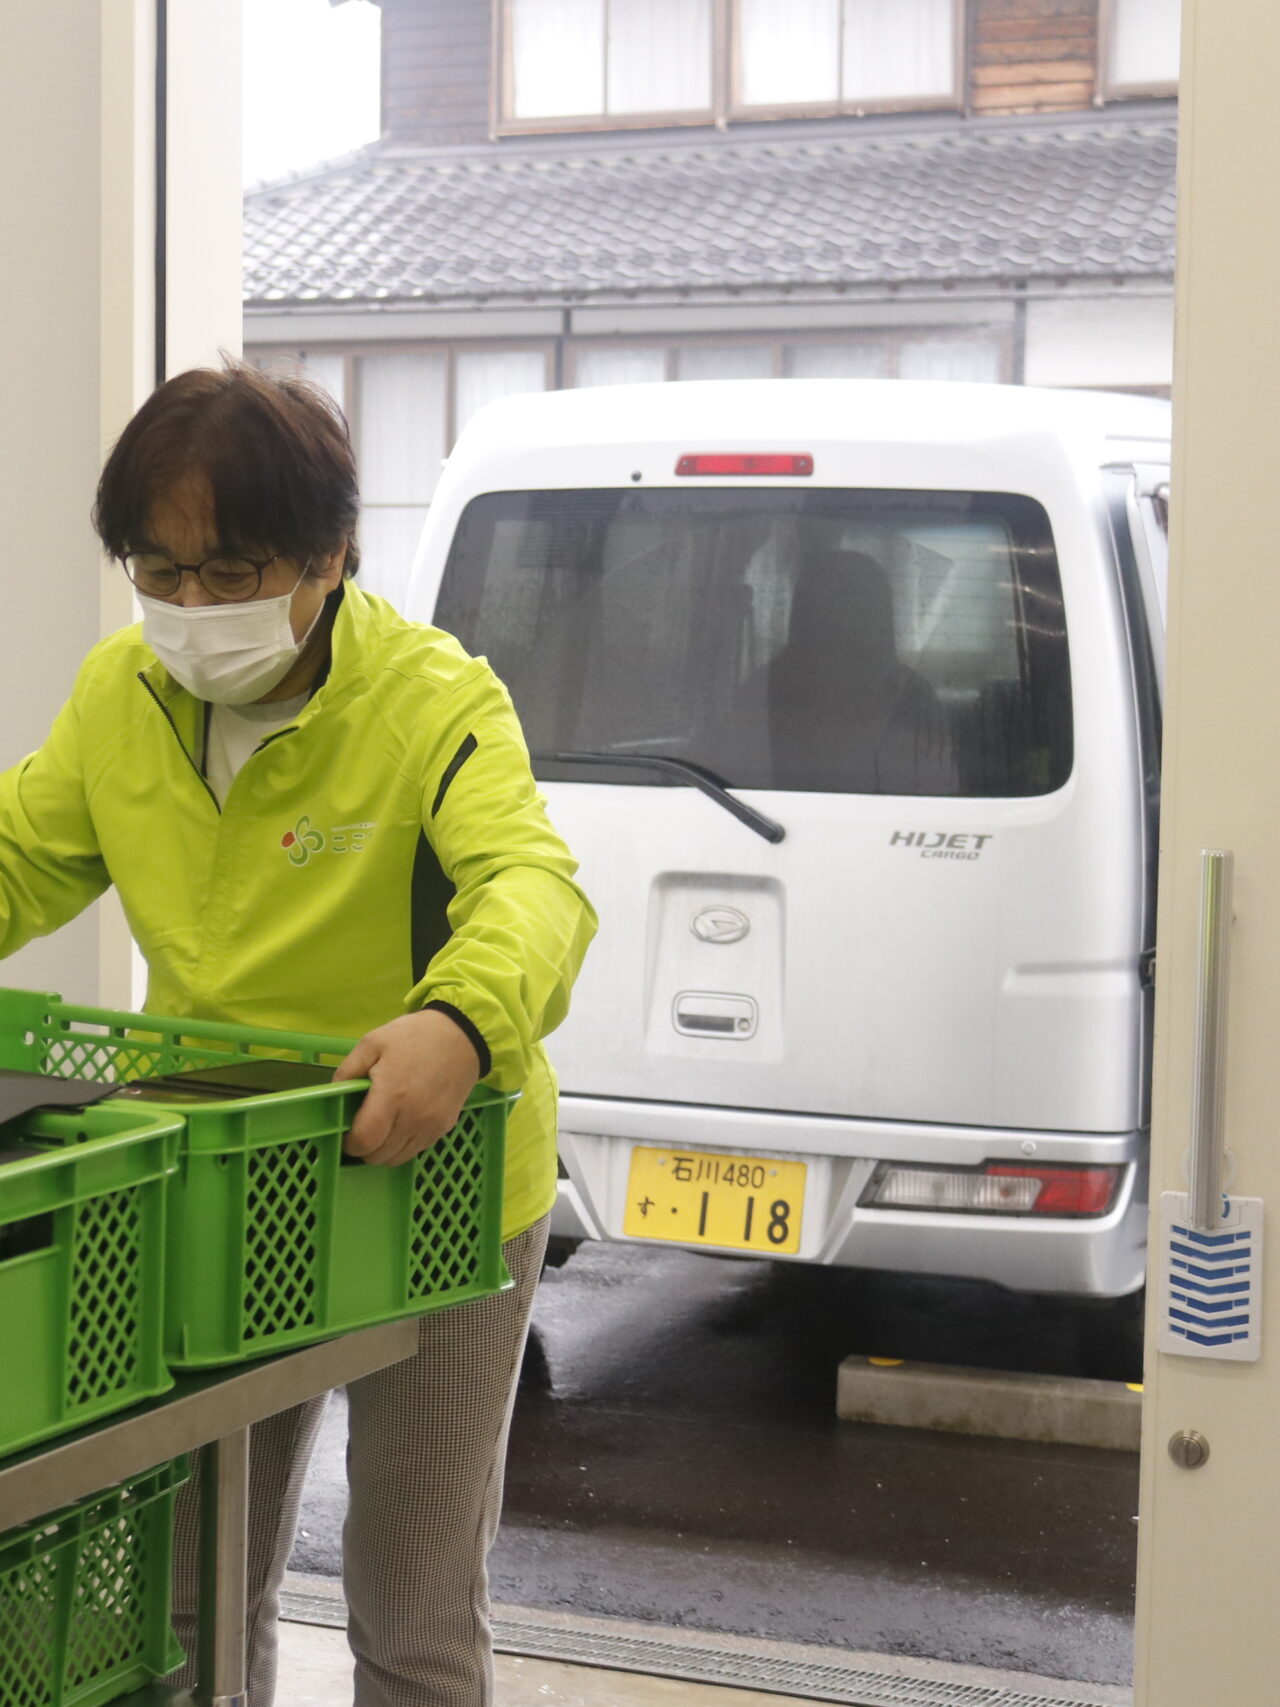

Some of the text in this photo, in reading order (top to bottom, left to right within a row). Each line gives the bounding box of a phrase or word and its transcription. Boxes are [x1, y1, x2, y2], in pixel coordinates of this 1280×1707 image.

[889, 830, 993, 850] HIJET
[920, 850, 981, 861] CARGO
[637, 1196, 655, 1219] す
